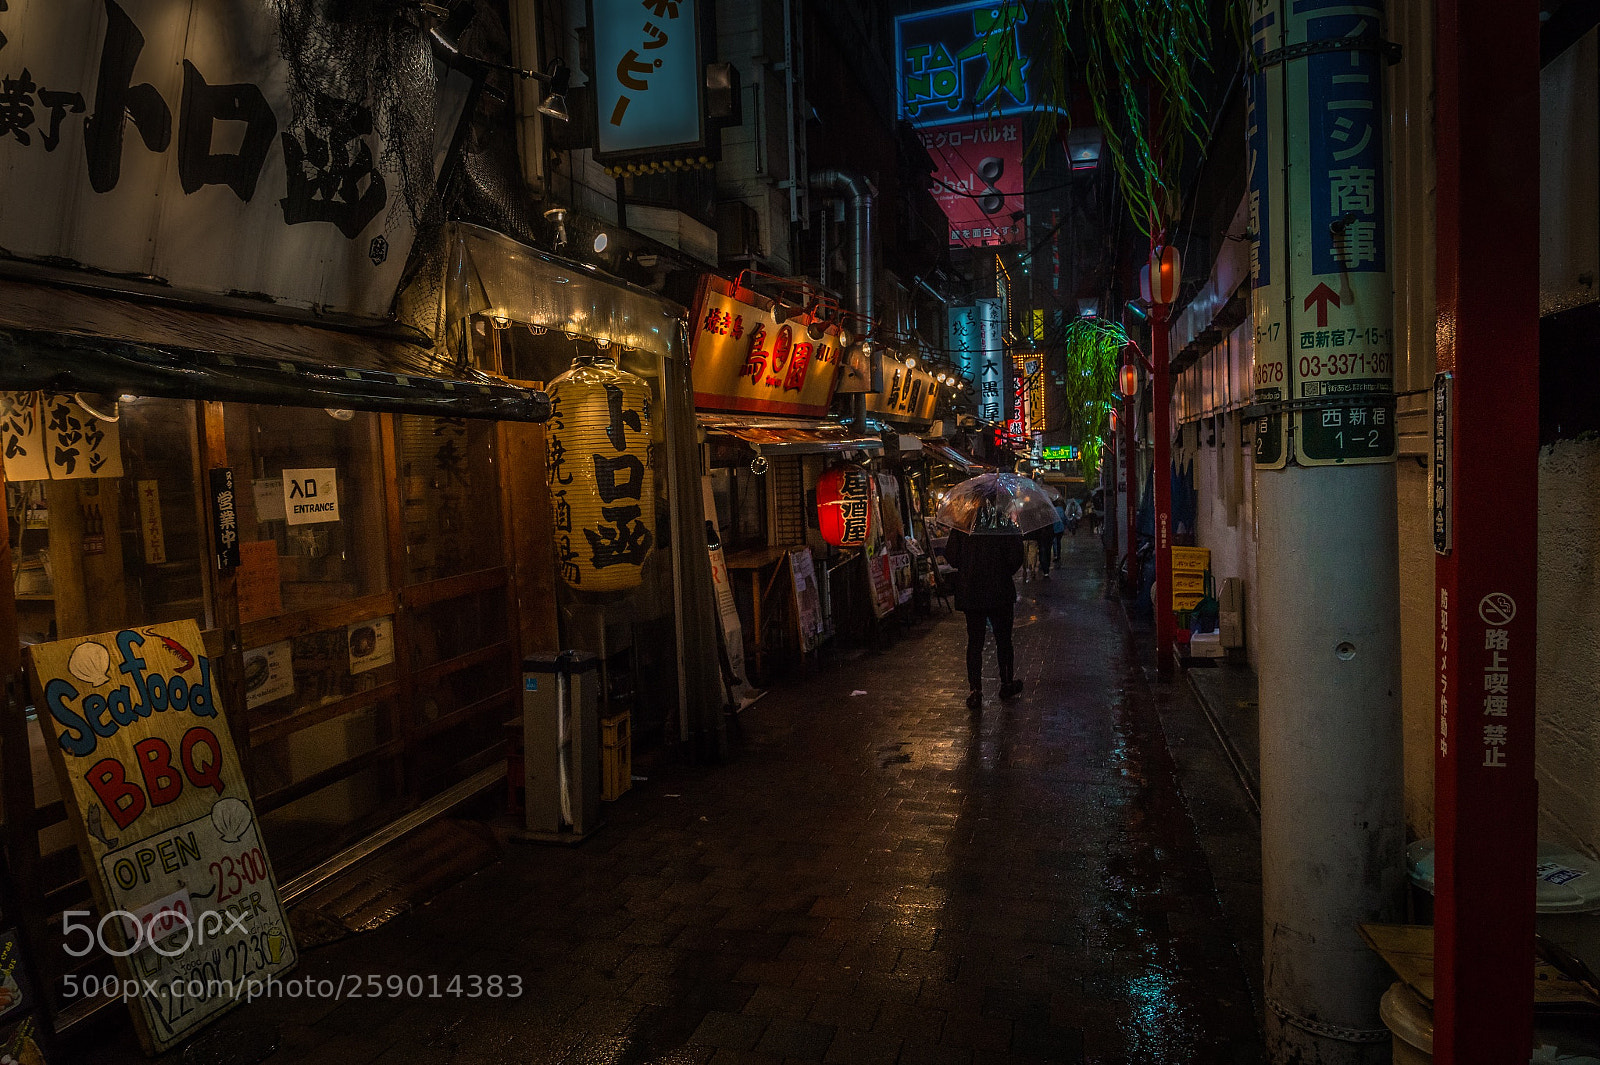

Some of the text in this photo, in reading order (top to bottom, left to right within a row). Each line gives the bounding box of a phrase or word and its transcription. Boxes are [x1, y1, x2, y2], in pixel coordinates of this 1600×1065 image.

[289, 478, 318, 499] 入口
[293, 502, 335, 514] ENTRANCE
[45, 630, 218, 758] Seafood
[84, 726, 226, 831] BBQ
[112, 831, 202, 890] OPEN
[203, 891, 267, 940] ORDER
